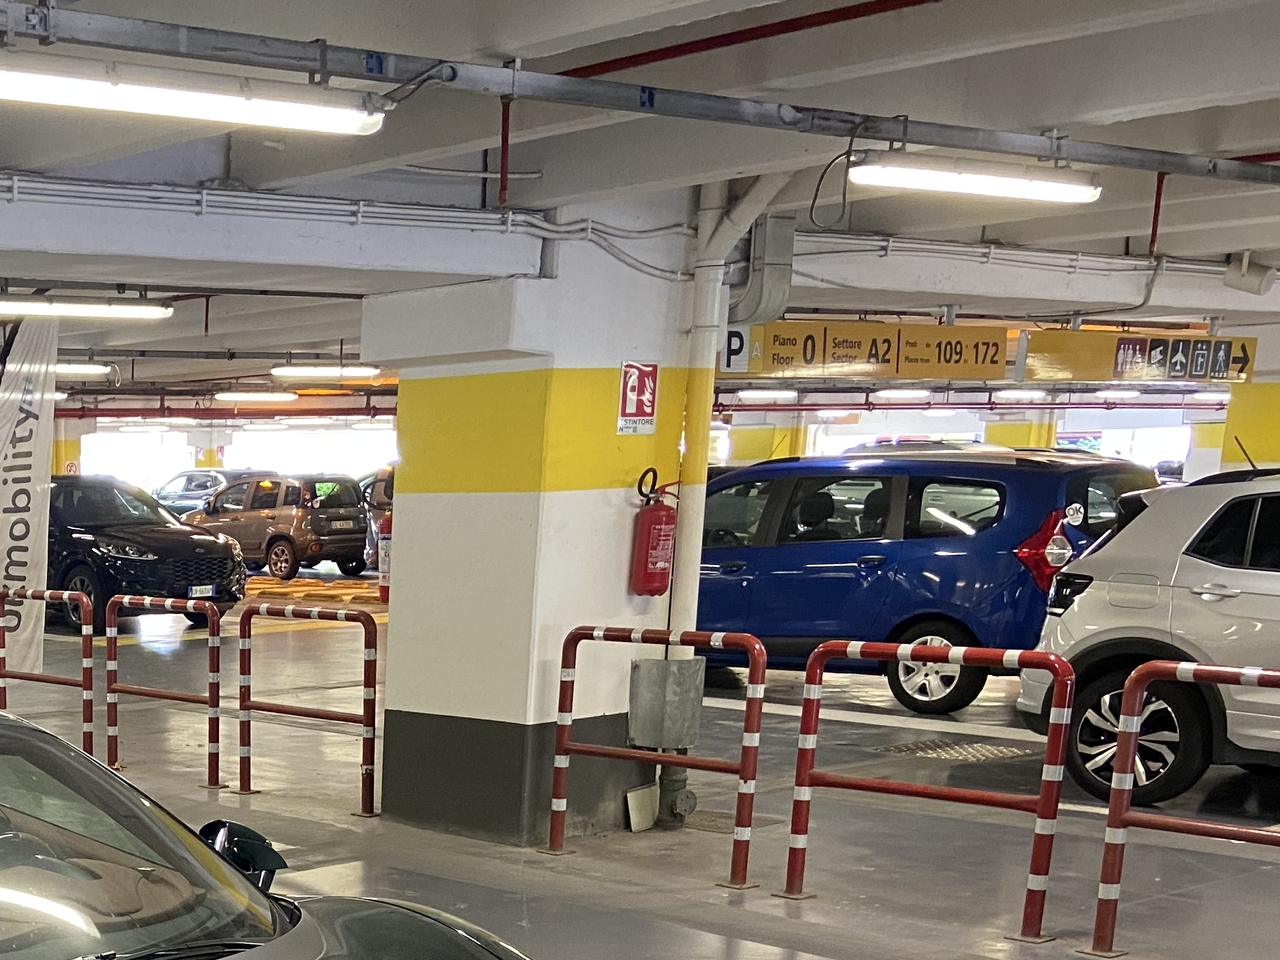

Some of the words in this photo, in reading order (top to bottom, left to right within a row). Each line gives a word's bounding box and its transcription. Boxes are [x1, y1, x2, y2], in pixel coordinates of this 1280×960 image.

[725, 330, 745, 367] P
[772, 334, 797, 346] Piano
[803, 334, 816, 365] 0
[832, 337, 862, 350] Settore
[866, 338, 892, 364] A2
[935, 340, 963, 364] 109
[973, 341, 999, 364] 172
[772, 353, 794, 365] Floor
[831, 352, 858, 364] Sector
[1067, 505, 1083, 517] OK
